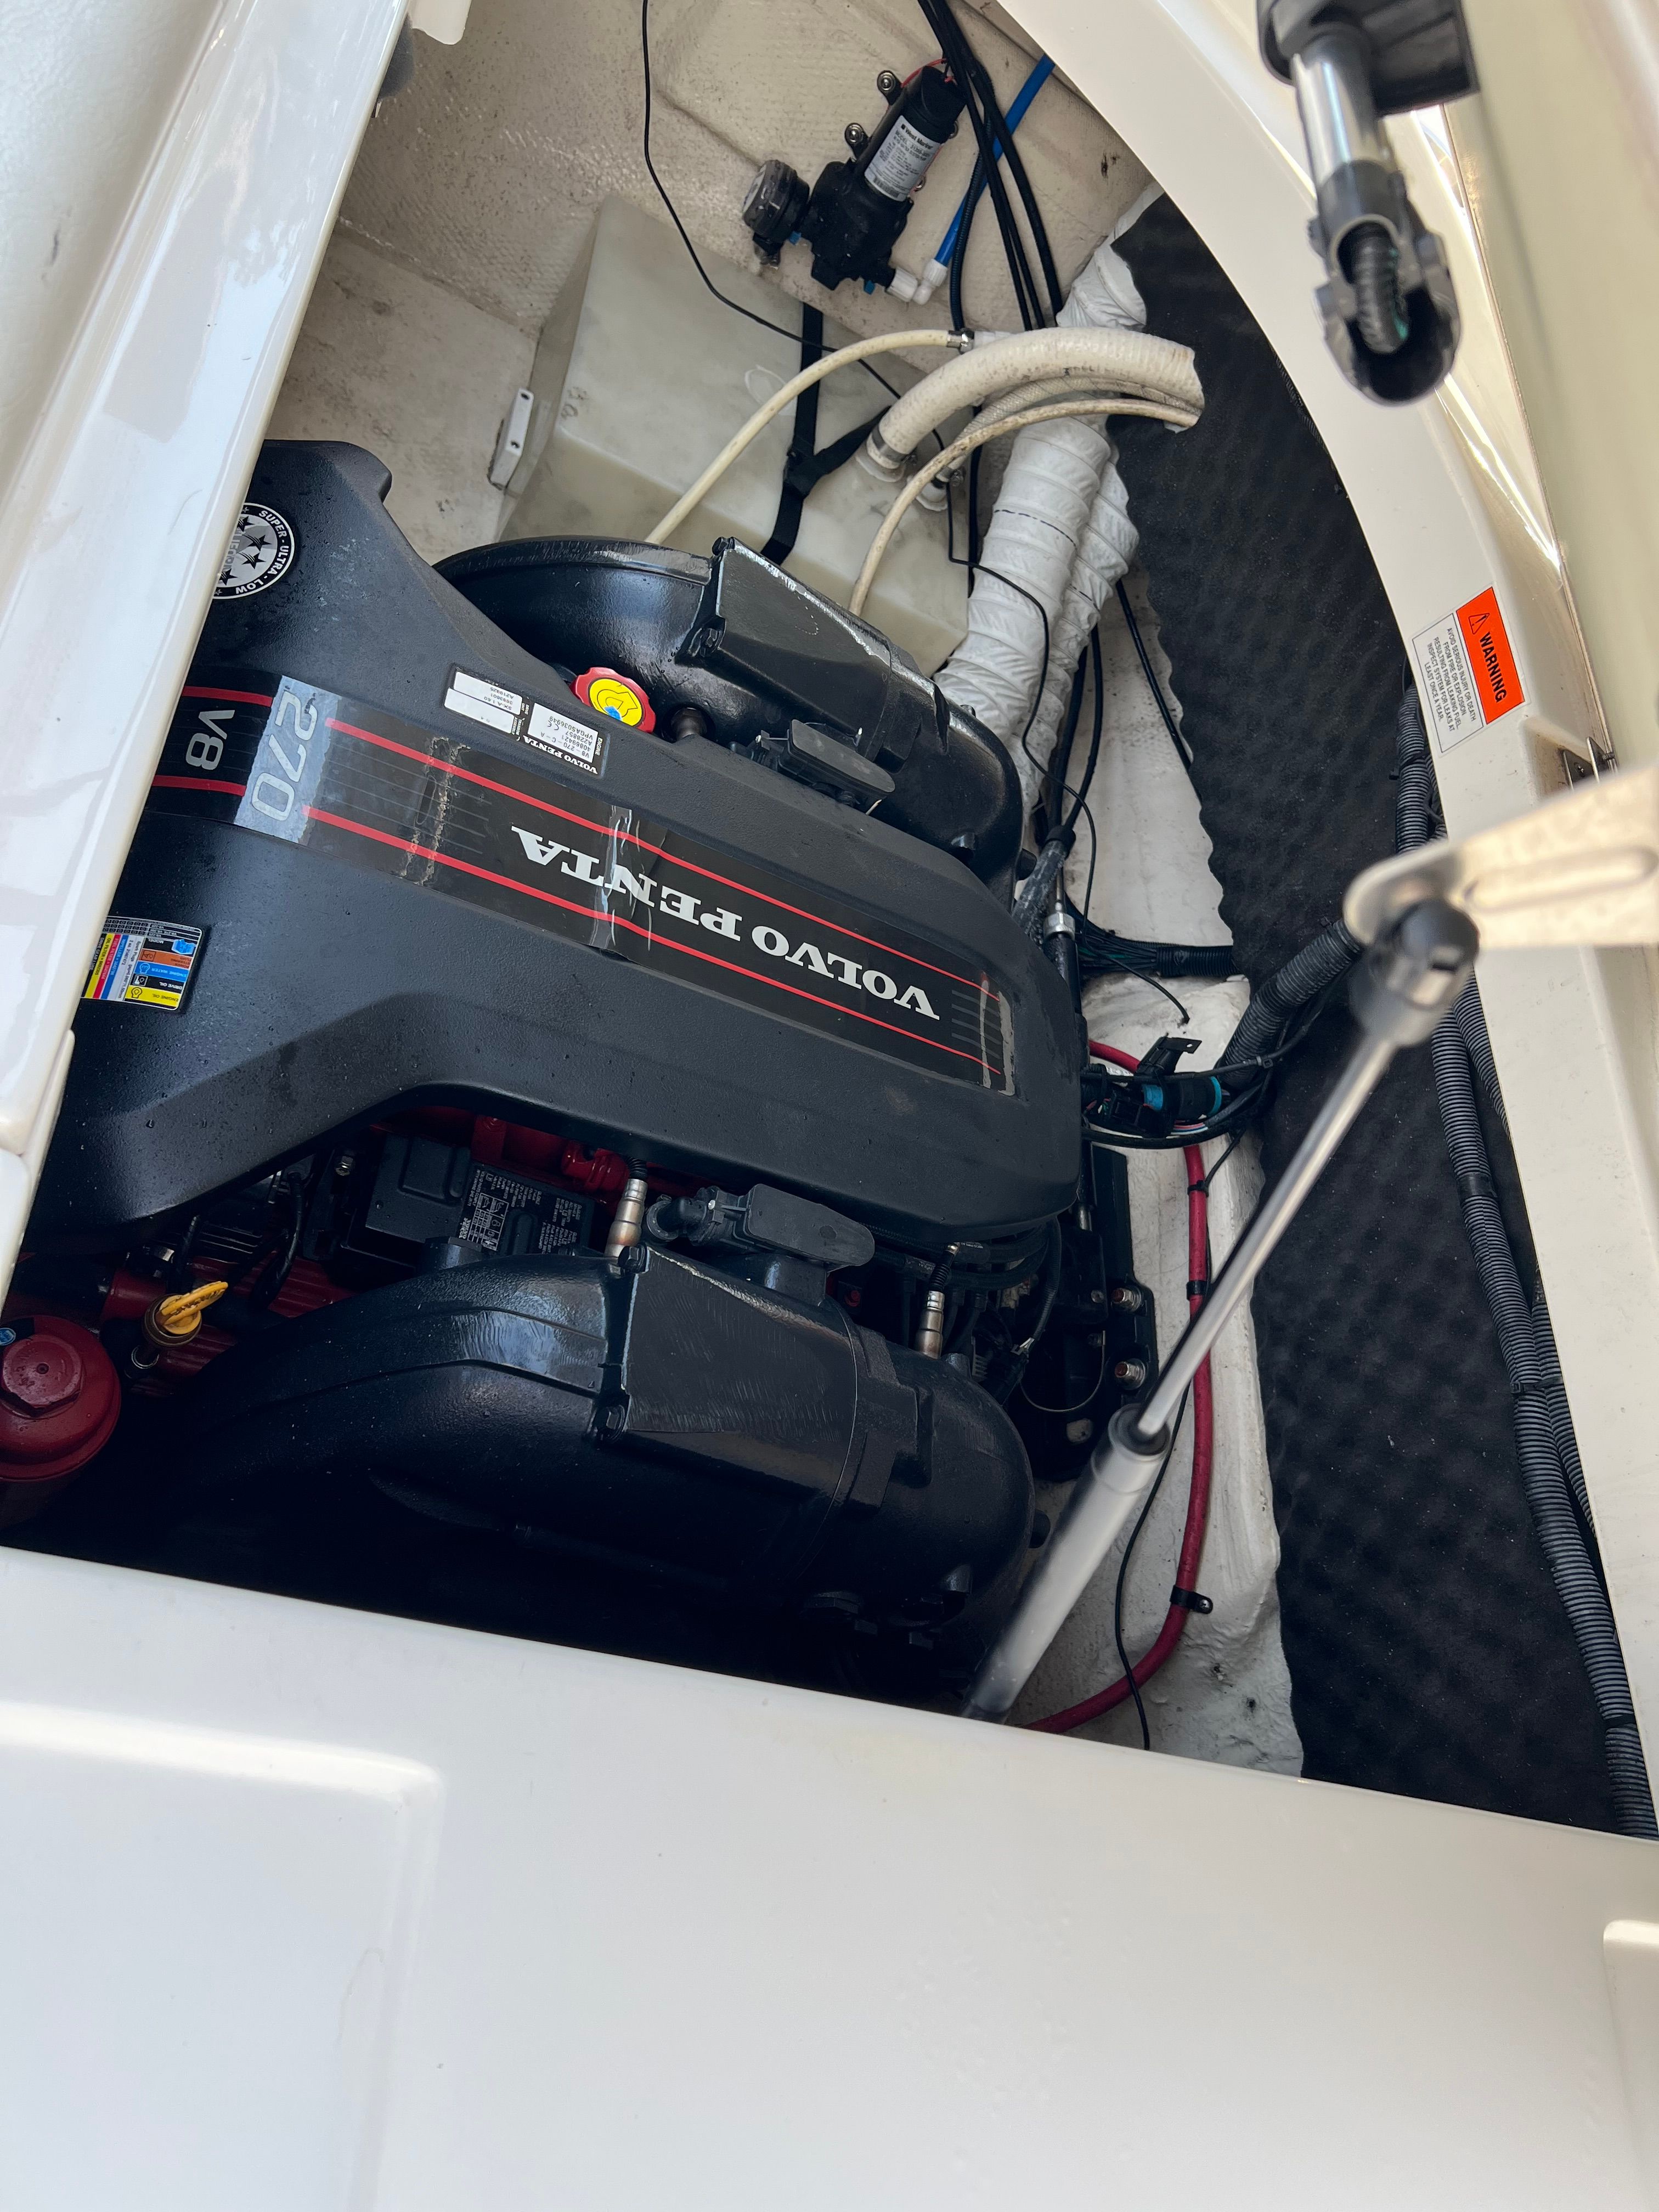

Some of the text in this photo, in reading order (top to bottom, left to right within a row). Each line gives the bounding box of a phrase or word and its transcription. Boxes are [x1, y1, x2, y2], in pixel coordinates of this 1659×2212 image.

[259, 510, 287, 538] SUPER
[267, 545, 289, 575] ULTRA
[235, 578, 264, 594] LOW
[1443, 641, 1452, 658] FROM
[1424, 662, 1434, 680] LEAST
[1430, 681, 1438, 698] ONCE
[1427, 642, 1437, 667] INSPECT
[1434, 668, 1444, 691] SYSTEM
[1443, 704, 1452, 724] LEAKS
[1434, 637, 1446, 669] RESULTING
[1447, 686, 1457, 712] LEAKING
[1447, 628, 1476, 721] AVOID SERIOUS INJURY OR DEATH
[1451, 673, 1458, 682] OR
[1480, 631, 1507, 703] WARNING
[1454, 682, 1466, 715] EXPLOSION
[185, 709, 235, 770] V8
[252, 691, 318, 822] 270
[522, 735, 597, 774] VOLVO PENTA
[563, 742, 574, 751] 270
[595, 737, 603, 757] ENGINE
[511, 826, 940, 1020] VOLVO PENTA
[117, 939, 126, 957] IMPELLER
